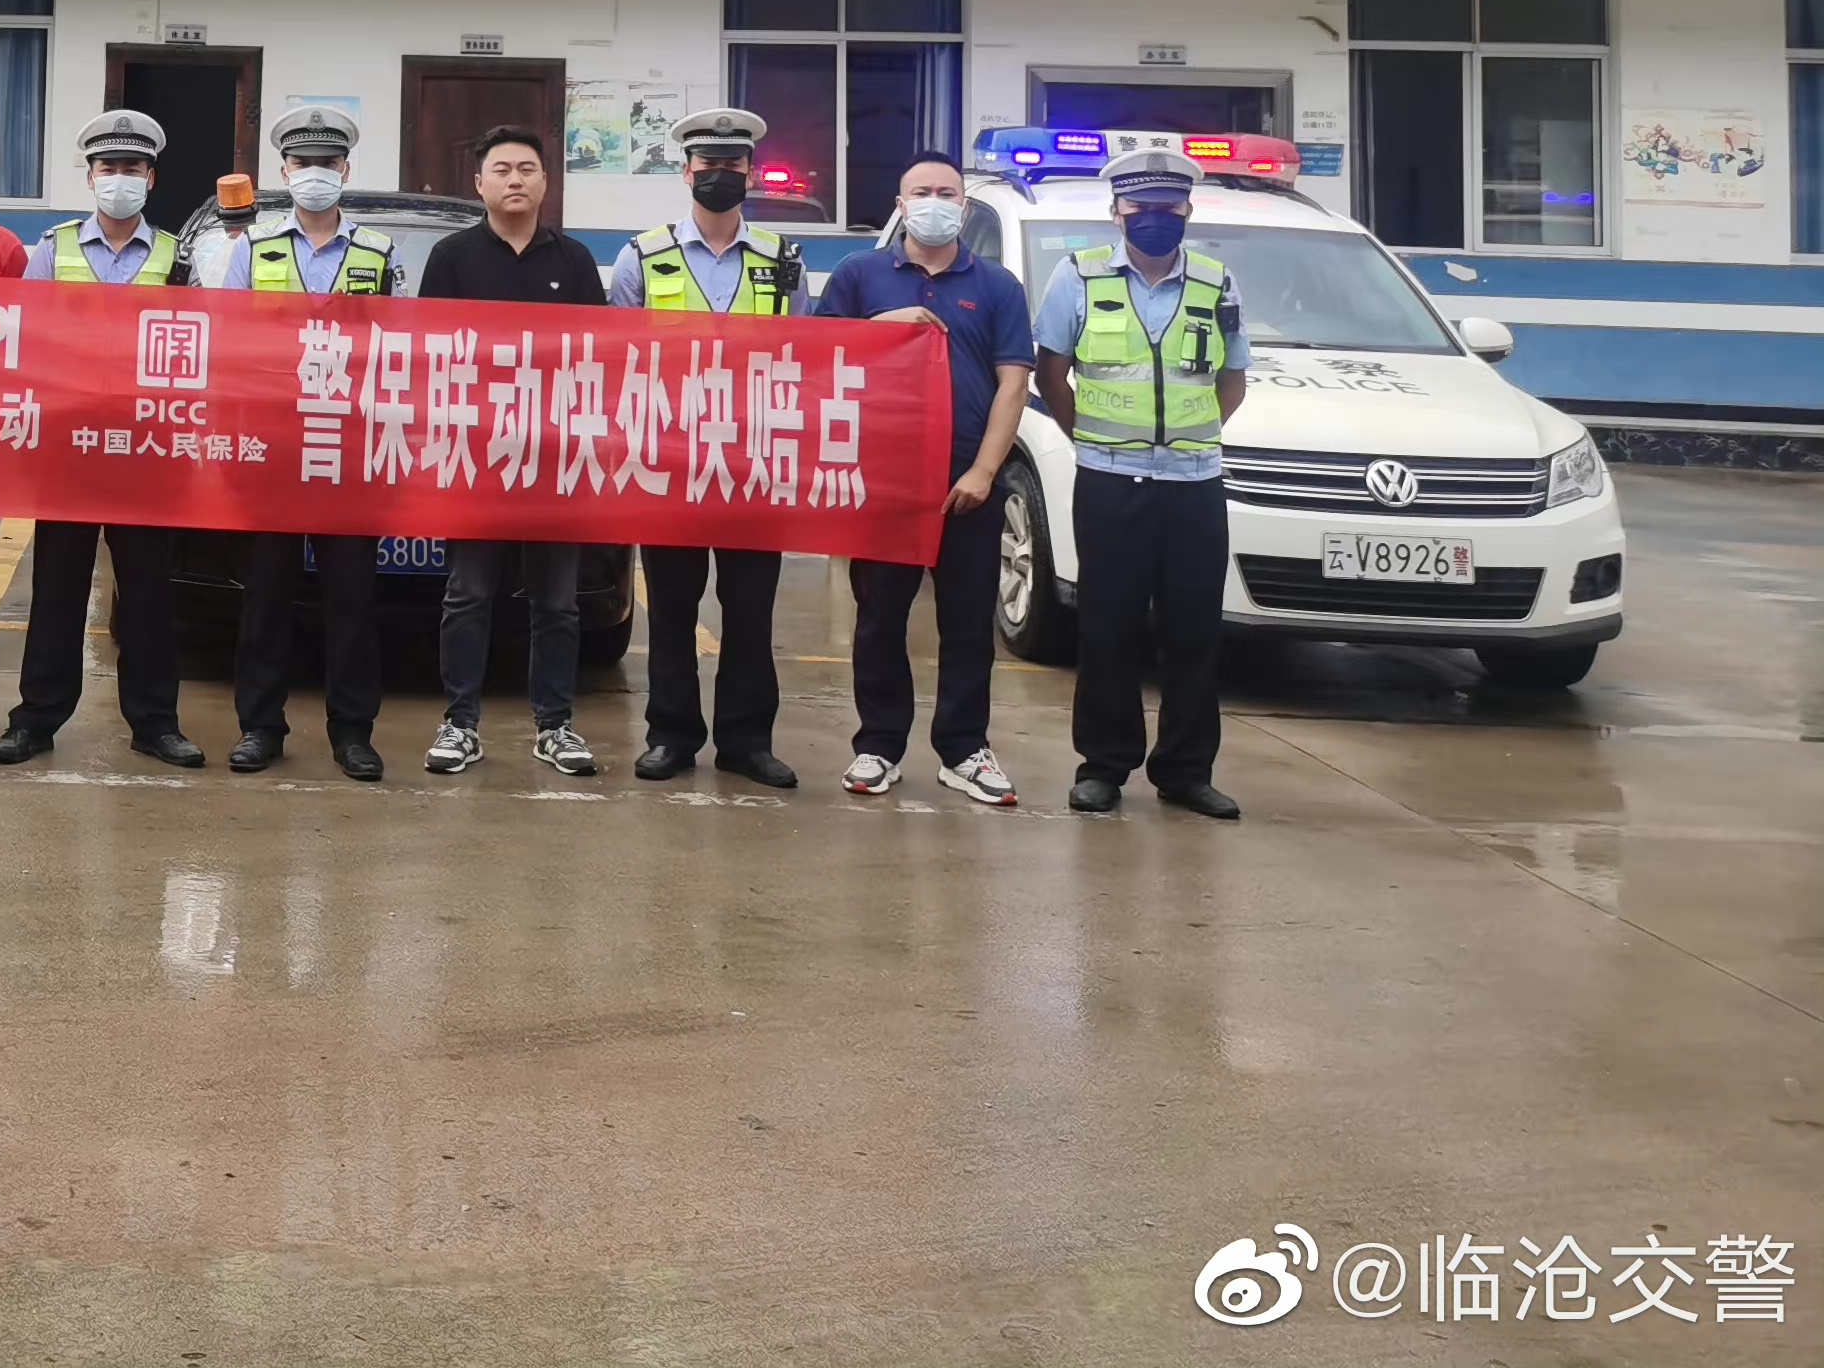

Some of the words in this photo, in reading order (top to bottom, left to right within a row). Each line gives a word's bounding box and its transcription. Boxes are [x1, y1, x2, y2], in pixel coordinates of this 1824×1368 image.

[135, 398, 207, 425] PICC
[296, 318, 868, 510] 警保联动快处快赔点
[71, 426, 269, 463] 中国人民保险
